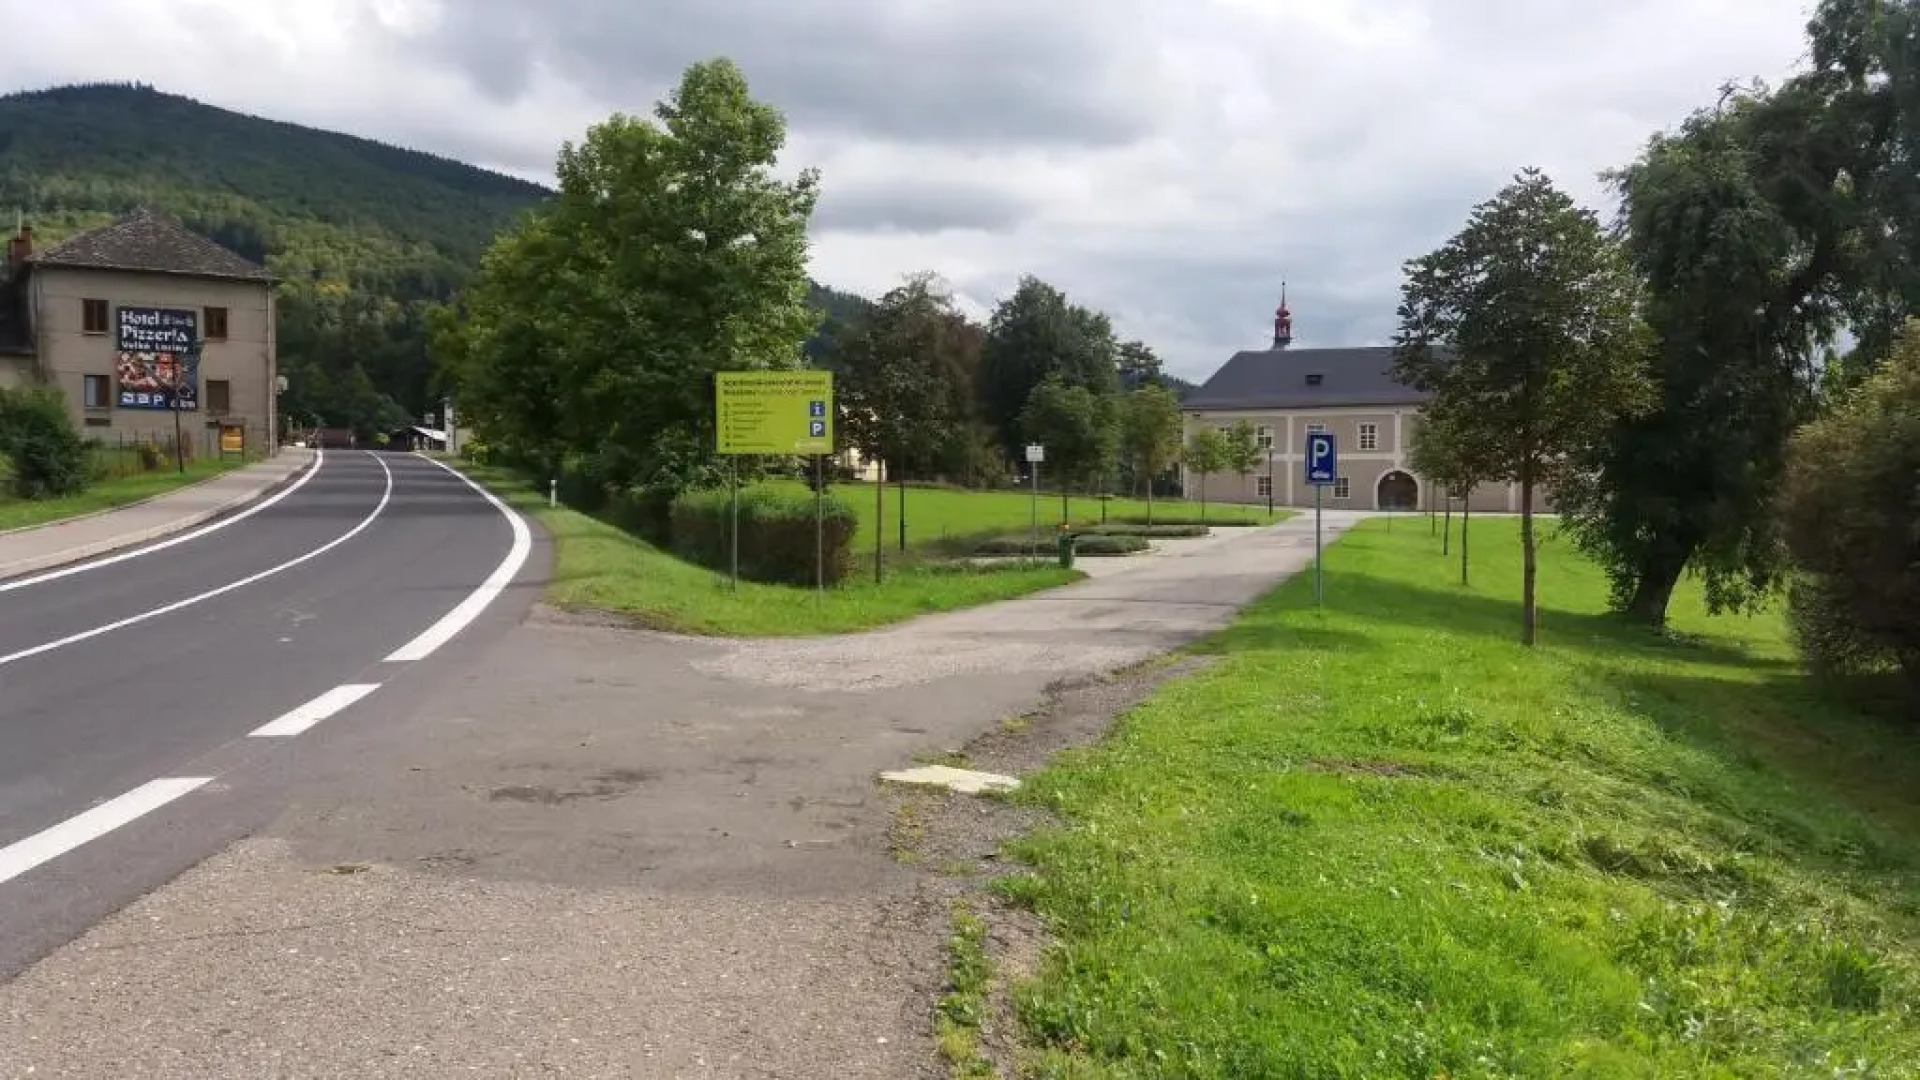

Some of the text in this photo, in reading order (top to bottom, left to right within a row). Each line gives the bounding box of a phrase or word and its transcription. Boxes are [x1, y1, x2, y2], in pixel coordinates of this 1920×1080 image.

[121, 310, 160, 325] Hotel
[813, 423, 822, 436] P
[1312, 438, 1330, 468] P
